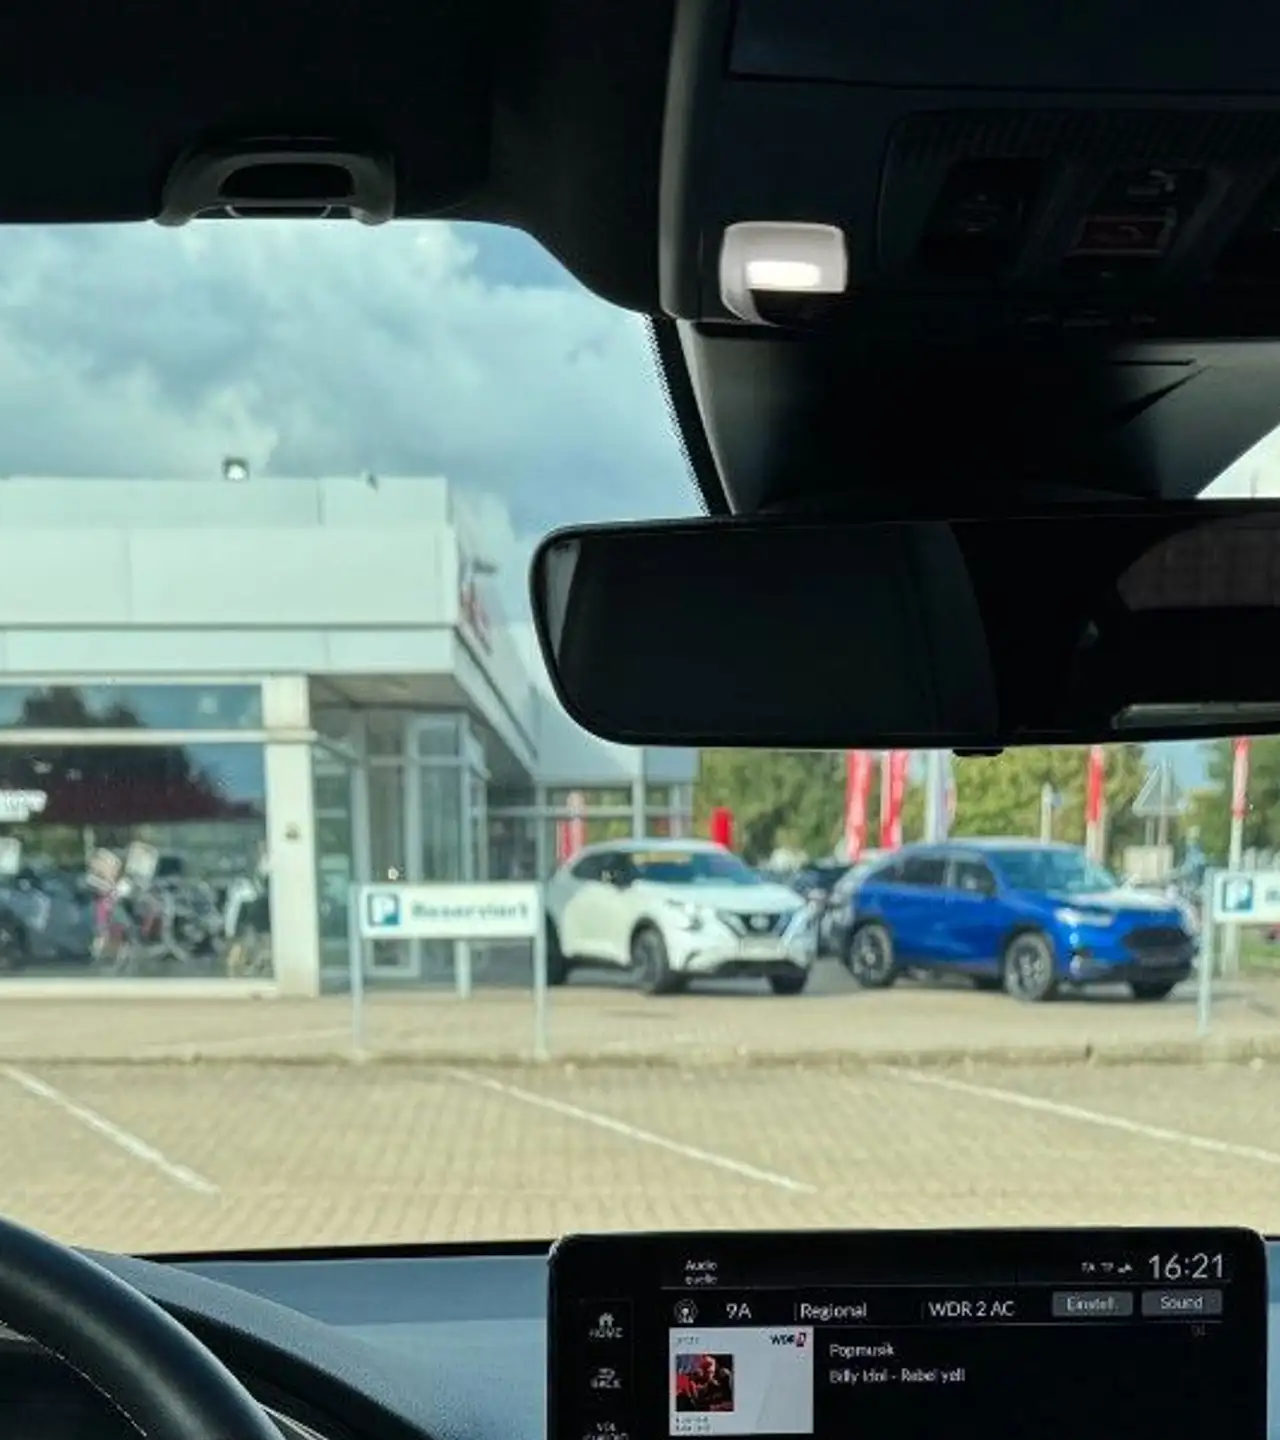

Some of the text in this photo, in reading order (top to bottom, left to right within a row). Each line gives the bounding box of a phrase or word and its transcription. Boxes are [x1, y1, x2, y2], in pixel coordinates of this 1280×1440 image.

[1149, 1252, 1224, 1280] 16:21
[725, 1299, 1015, 1319] 9A Regional WDR 2 AC
[1160, 1294, 1204, 1310] Sound
[829, 1342, 895, 1359] Popmusik
[901, 1368, 937, 1383] Rebel
